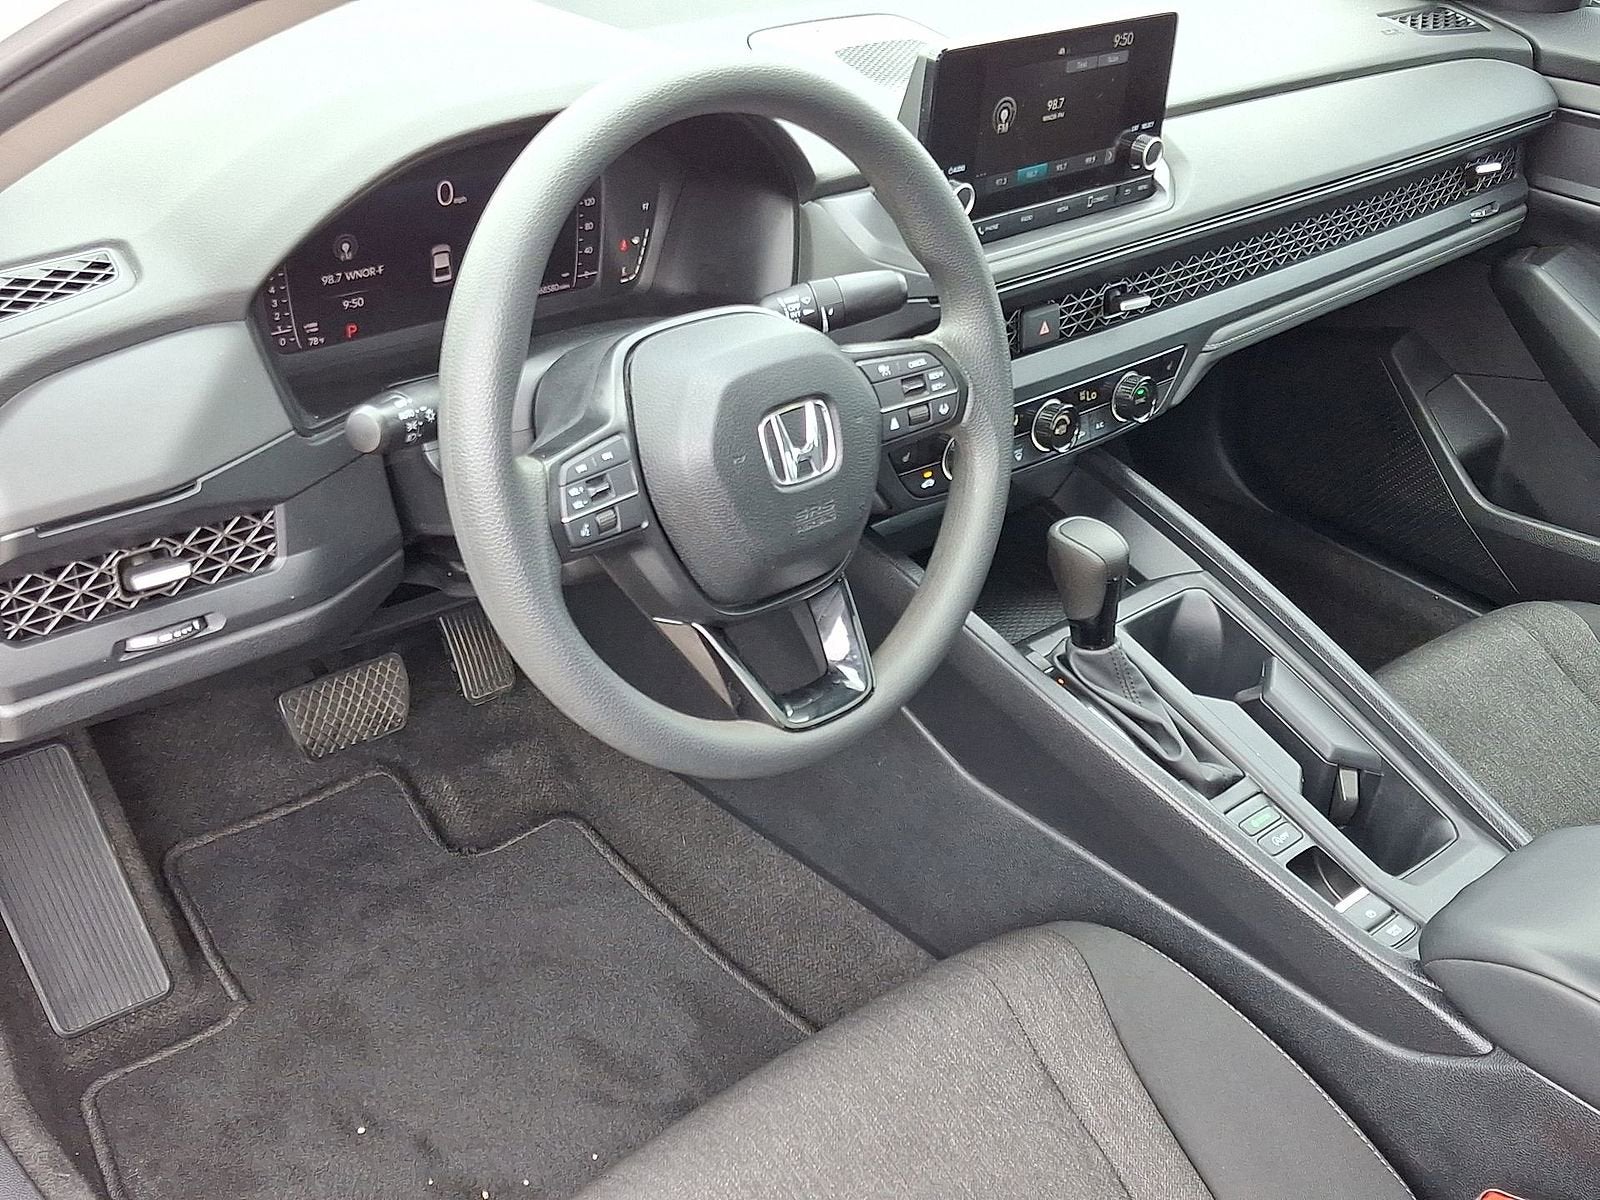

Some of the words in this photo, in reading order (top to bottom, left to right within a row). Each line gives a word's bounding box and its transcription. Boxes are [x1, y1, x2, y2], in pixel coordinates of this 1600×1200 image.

[1113, 32, 1135, 49] 9:50
[1047, 97, 1066, 112] 98.7
[437, 181, 454, 206] 0
[584, 222, 594, 231] 80
[584, 246, 593, 254] 40
[321, 272, 343, 286] 98.7
[344, 264, 385, 281] WNOR-F
[271, 299, 278, 308] 3
[342, 297, 365, 310] 9:50
[273, 312, 280, 321] 2
[346, 323, 358, 338] P
[279, 337, 287, 347] 0
